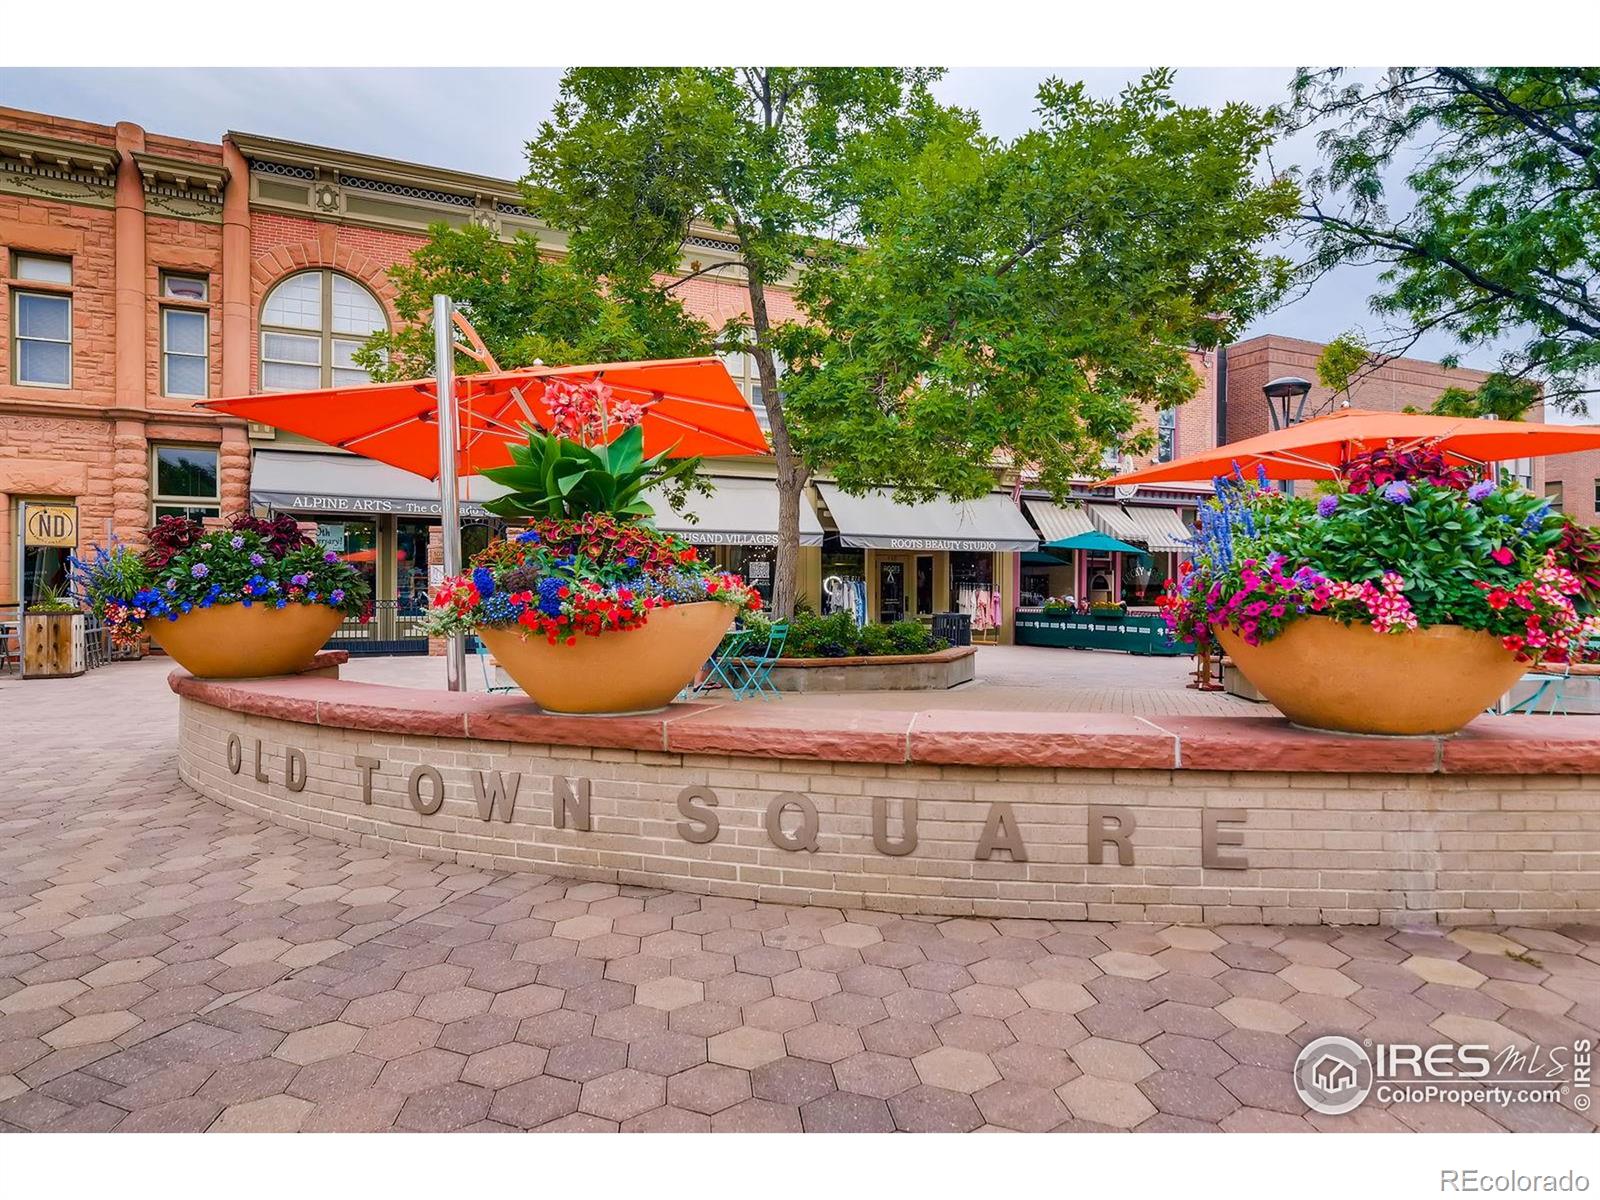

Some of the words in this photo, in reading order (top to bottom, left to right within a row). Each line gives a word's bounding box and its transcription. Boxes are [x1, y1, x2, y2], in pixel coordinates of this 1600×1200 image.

[292, 496, 348, 509] ALPINE
[353, 499, 392, 511] ARTS
[405, 503, 428, 512] The
[39, 514, 65, 537] ND
[725, 533, 779, 544] VILLAGES
[891, 538, 923, 549] ROOTS
[925, 539, 960, 550] BEAUTY
[962, 541, 996, 551] STUDIO
[226, 732, 307, 792] OLD
[354, 755, 591, 832] TOWN
[676, 785, 1249, 870] SQUARE
